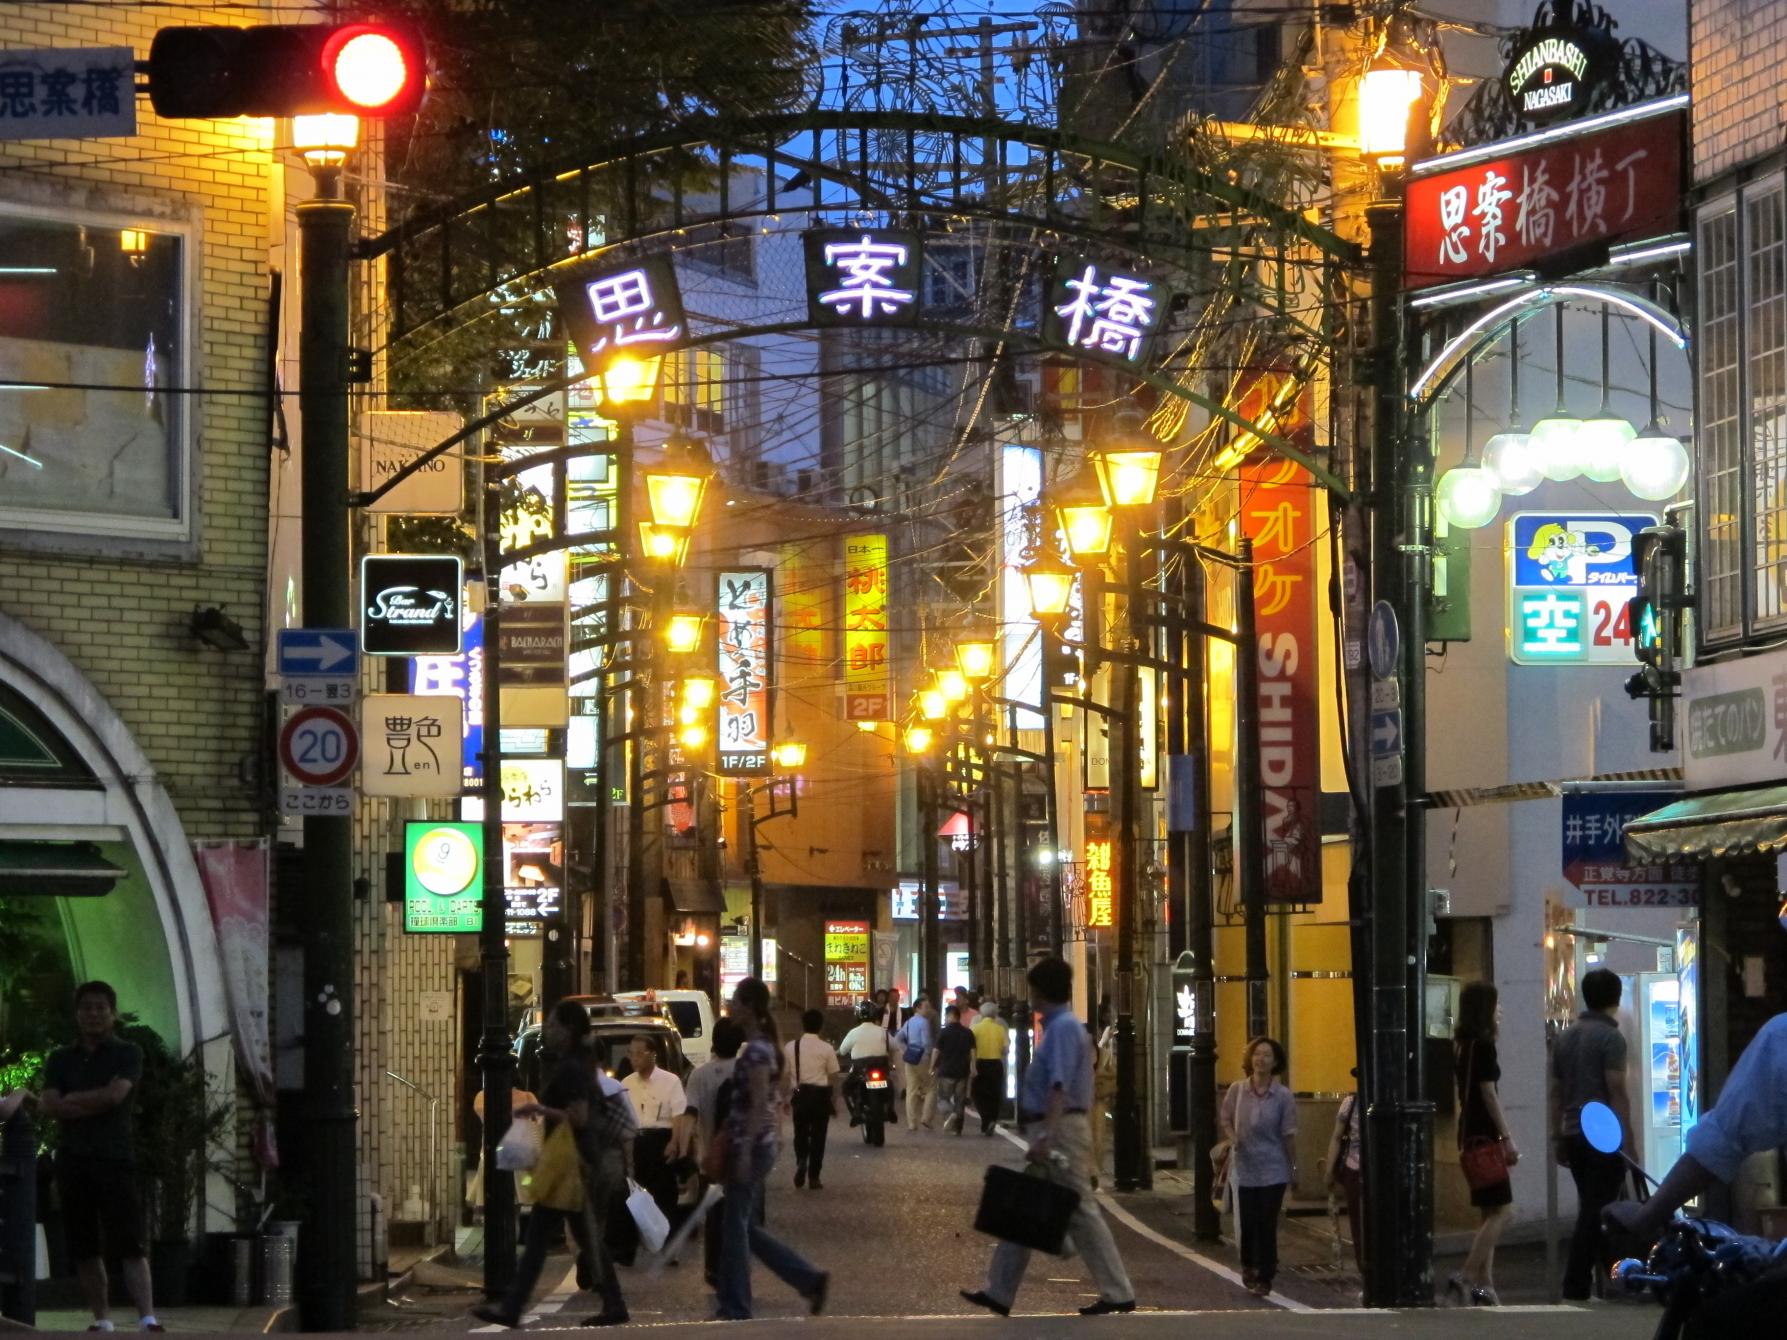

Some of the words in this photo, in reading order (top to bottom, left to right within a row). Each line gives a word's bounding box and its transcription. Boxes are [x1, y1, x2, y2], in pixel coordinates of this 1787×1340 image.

[1510, 38, 1587, 96] SHIANBASHI
[0, 67, 121, 118] 思案橋
[1523, 82, 1572, 111] NAGASAKI
[1439, 149, 1648, 264] 思案橋横丁
[848, 545, 884, 554] 日本一
[368, 586, 442, 619] Strand
[848, 566, 886, 671] 桃太郎
[1523, 594, 1581, 652] 空
[853, 697, 883, 717] 2F
[297, 729, 342, 764] 20
[413, 760, 431, 770] en
[721, 755, 766, 769] 1F/2F
[285, 794, 350, 811] ここから
[1566, 813, 1641, 845] 井手外
[536, 887, 560, 903] 2F
[1086, 842, 1113, 926] 雑魚屋
[826, 942, 867, 954] まねきねこ
[827, 964, 846, 982] 24h
